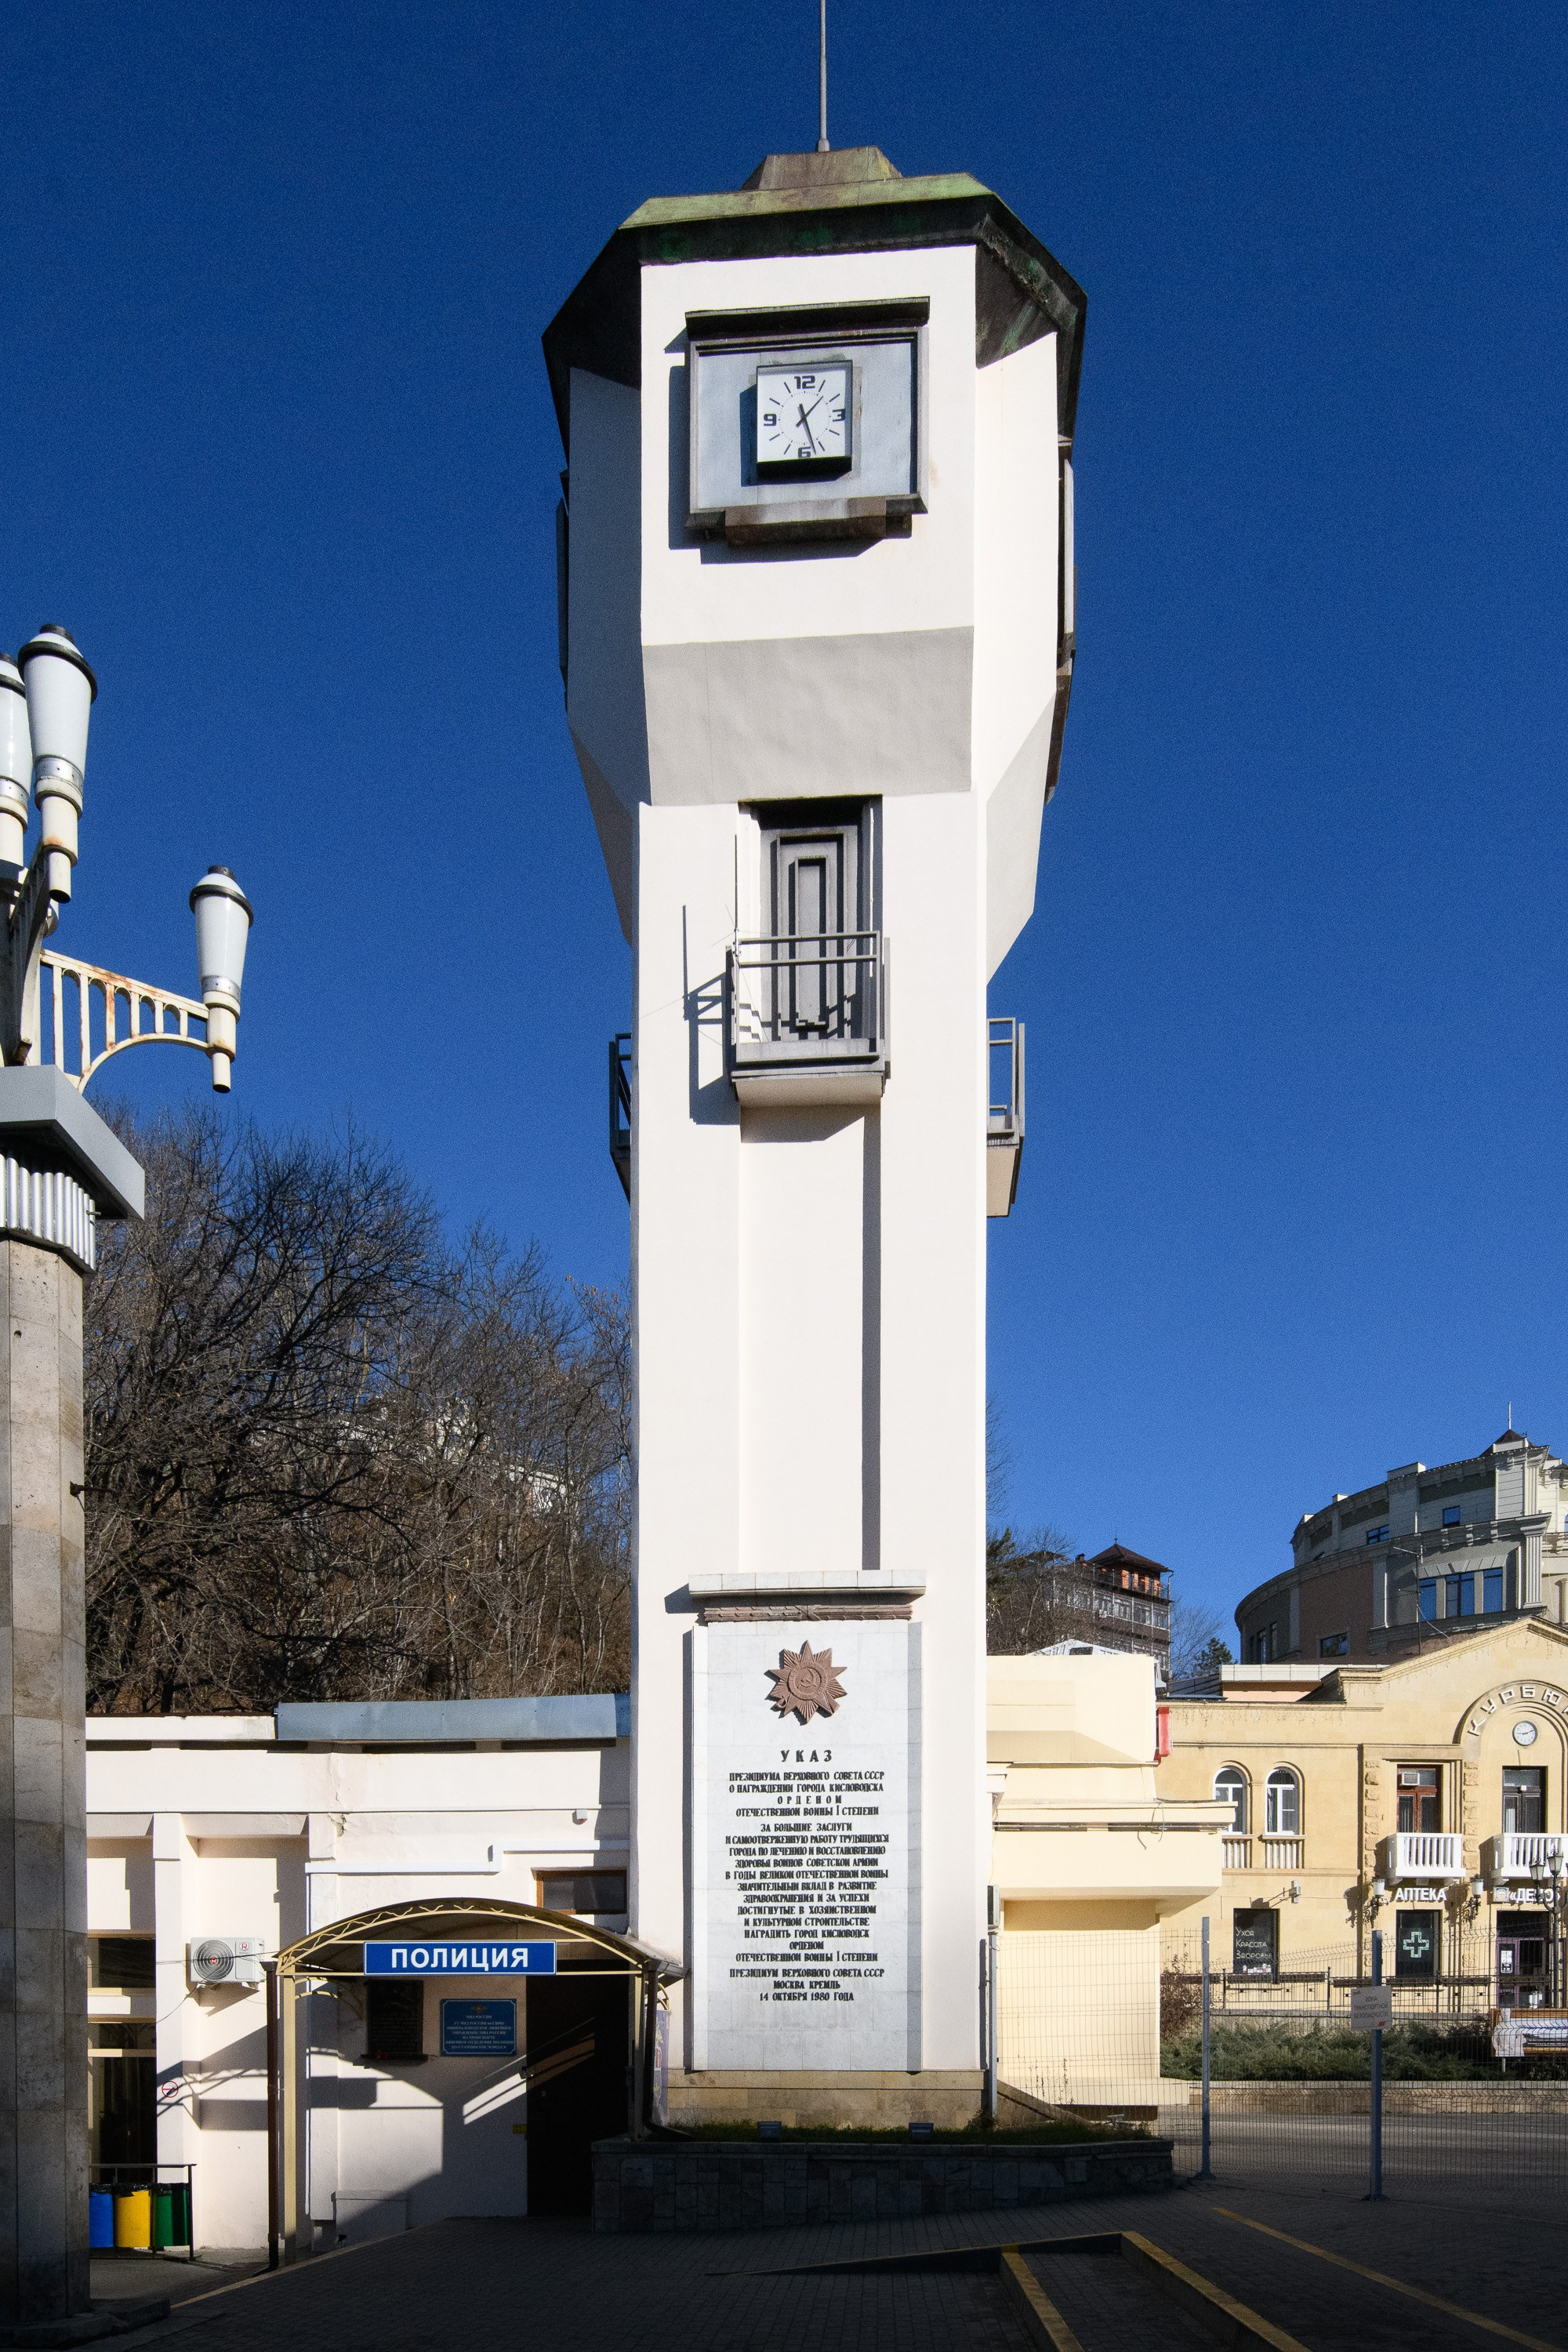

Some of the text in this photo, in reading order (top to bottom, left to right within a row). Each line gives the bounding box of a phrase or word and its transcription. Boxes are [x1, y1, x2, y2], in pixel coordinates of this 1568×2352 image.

[794, 376, 815, 390] 12
[764, 413, 777, 426] 9
[832, 408, 846, 422] 3
[797, 447, 811, 459] 6
[1467, 1686, 1568, 1737] КУРБЮ
[781, 1749, 832, 1762] УКАЗ
[729, 1771, 884, 1782] ПРЕЗИДИУМА ВЕРХОВНОГО СОВЕТА СССР
[729, 1783, 884, 1794] О НАГРАЖДЕНИИ ГОРОДА КИСЛОВОДСКА
[778, 1795, 842, 1805] ОРДЕНОМ
[842, 1806, 879, 1816] СТЕПЕНИ
[760, 1822, 852, 1832] ЗА БОЛЬШИЕ ЗАСЛУГИ
[726, 1833, 889, 1845] И САМООТВЕРЖЕННУЮ РАБОТУ ТРУДЯЩИХСЯ
[730, 1846, 886, 1857] ГОРОДА ПО ЛЕЧЕНИЮ И ВОССТАНОВЛЕНИЮ
[735, 1858, 771, 1867] ЗДОРОВЬЯ
[774, 1858, 803, 1867] ВОИНОВ
[853, 1857, 878, 1867] АРМИИ
[726, 1871, 731, 1880] В
[734, 1870, 756, 1879] ГОДЫ
[801, 1881, 826, 1891] ВКЛАД
[829, 1881, 834, 1890] В
[838, 1881, 877, 1890] РАЗВИТИЕ
[743, 1893, 869, 1903] ЗДРАВООХРАНЕНИЯ И ЗА УСПЕХИ
[1395, 1887, 1447, 1900] АПТЕКА
[738, 1905, 795, 1915] ДОСТИГНУТЫЕ
[799, 1905, 804, 1915] В
[744, 1917, 869, 1927] И КУЛЬТУРНОМ СТРОИТЕЛЬСТВЕ
[744, 1929, 869, 1939] НАГРАДИТЬ ГОРОД КИСЛОВОДСК
[789, 1940, 824, 1951] ОРДЕНОМ
[391, 1947, 529, 1972] ПОЛИЦИЯ
[842, 1952, 878, 1962] СТЕПЕНИ
[730, 1968, 884, 1979] ПРЕЗИДИУМ ВЕРХОВНОГО СОВЕТА СССР
[774, 1980, 840, 1990] МОСКВА КРЕМЛЬ
[760, 1991, 855, 2002] 14 ОКТЯБРЯ 1980 ГОДА
